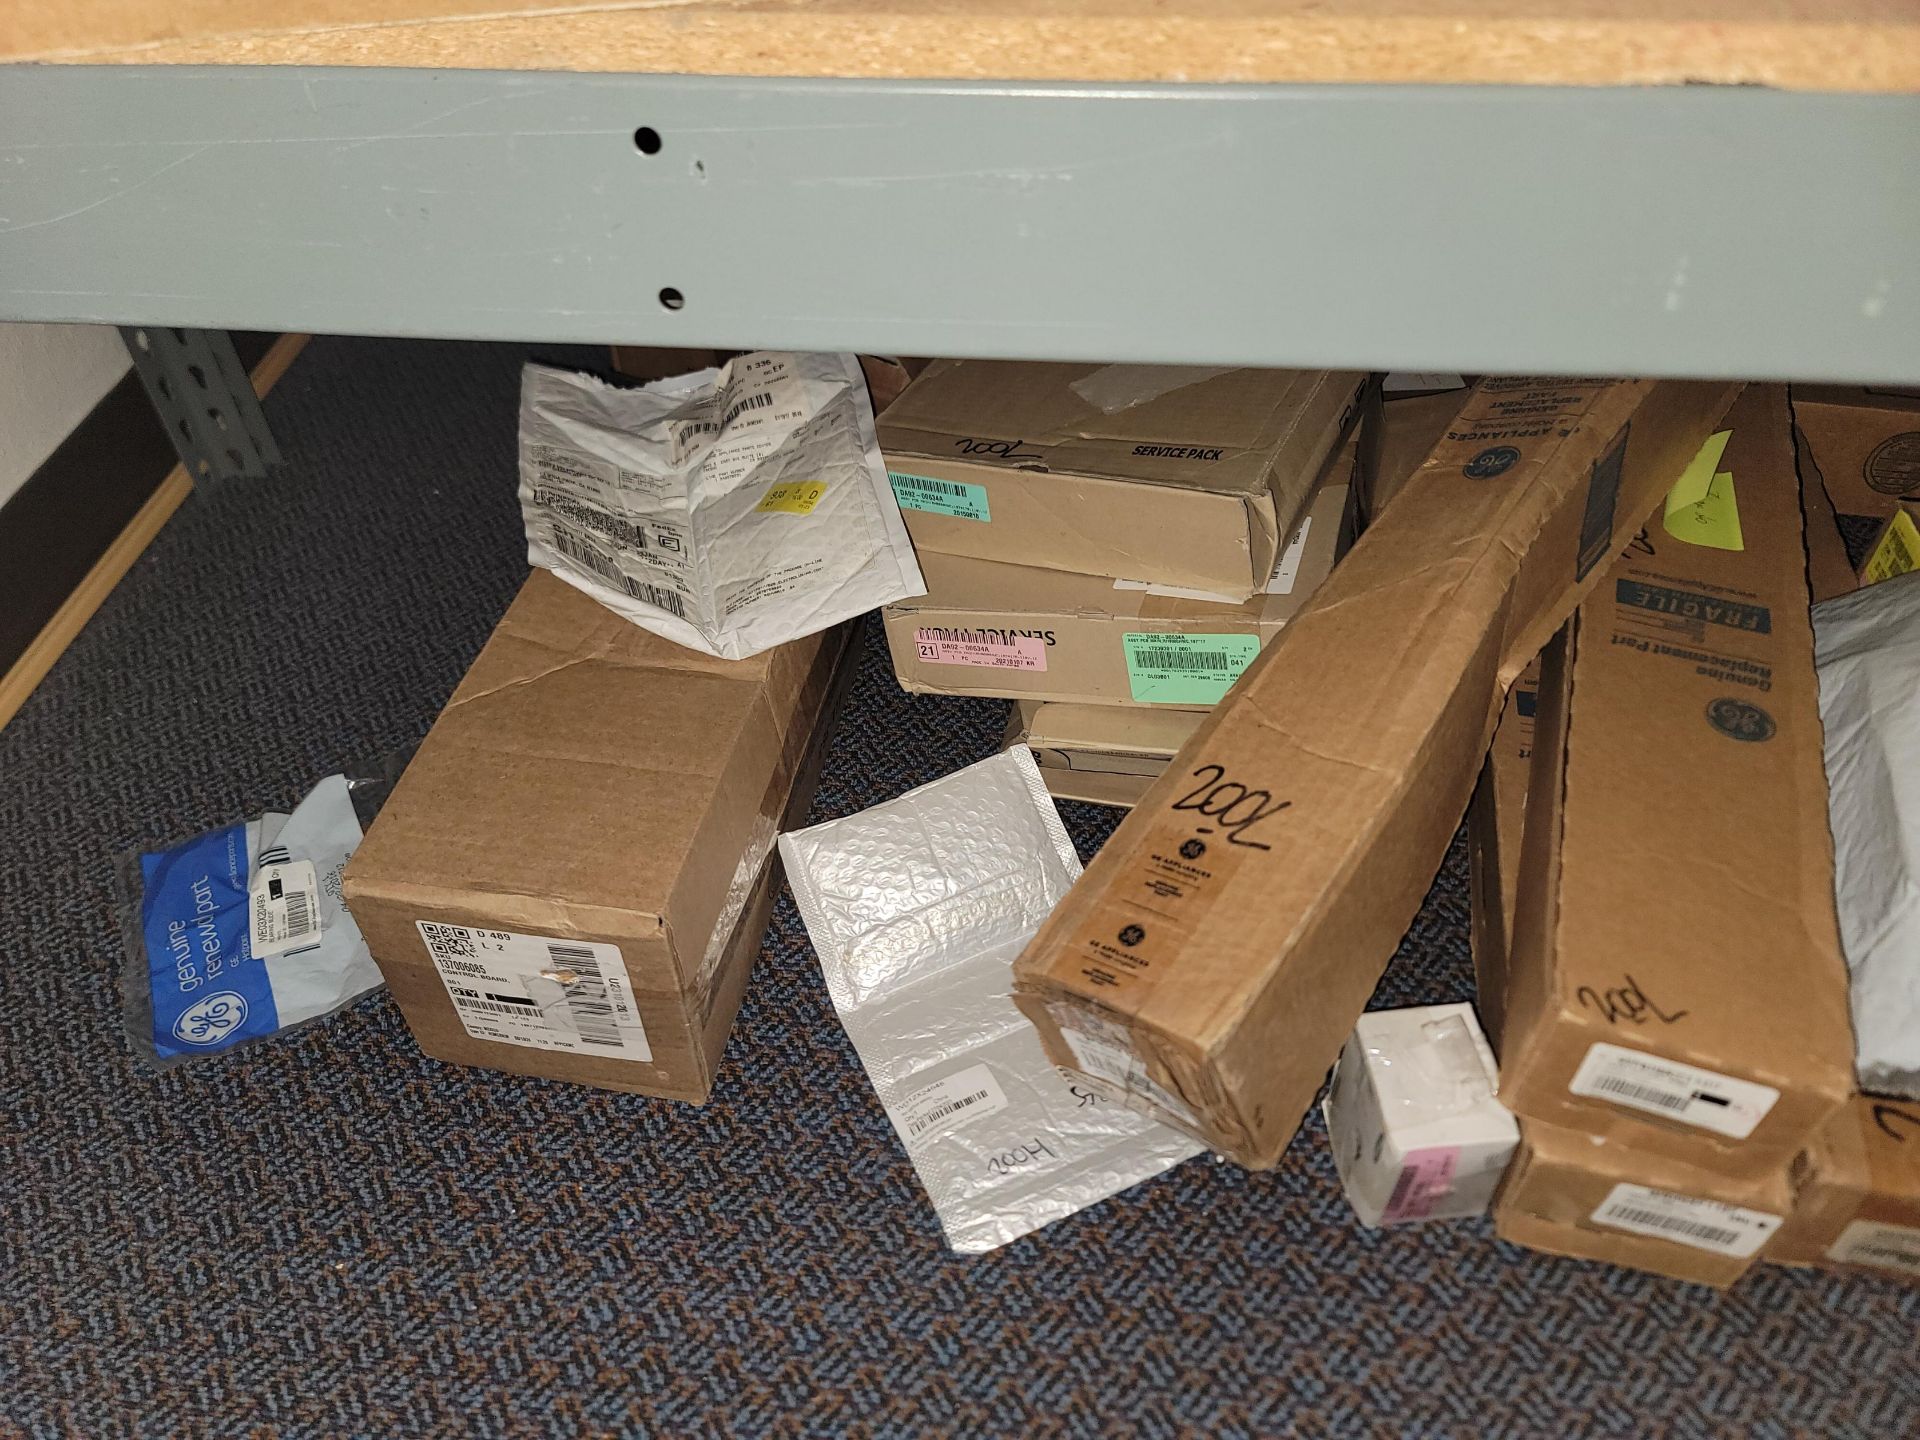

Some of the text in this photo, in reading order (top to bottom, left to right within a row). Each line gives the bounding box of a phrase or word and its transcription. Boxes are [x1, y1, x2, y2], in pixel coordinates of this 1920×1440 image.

[1448, 428, 1555, 442] APPLIANCES
[1132, 445, 1224, 461] SERVICE PACK
[1635, 590, 1761, 630] FRAGILE
[920, 645, 934, 656] 21
[1610, 634, 1772, 679] Replacement Part
[1230, 659, 1244, 667] 041
[1695, 665, 1772, 692] Genuine
[191, 874, 221, 914] part
[476, 930, 511, 941] D 489
[481, 941, 504, 952] L 2
[167, 919, 204, 993] genuine
[438, 959, 488, 976] 137006085
[442, 968, 480, 979] CONTROL
[450, 986, 480, 999] QTY
